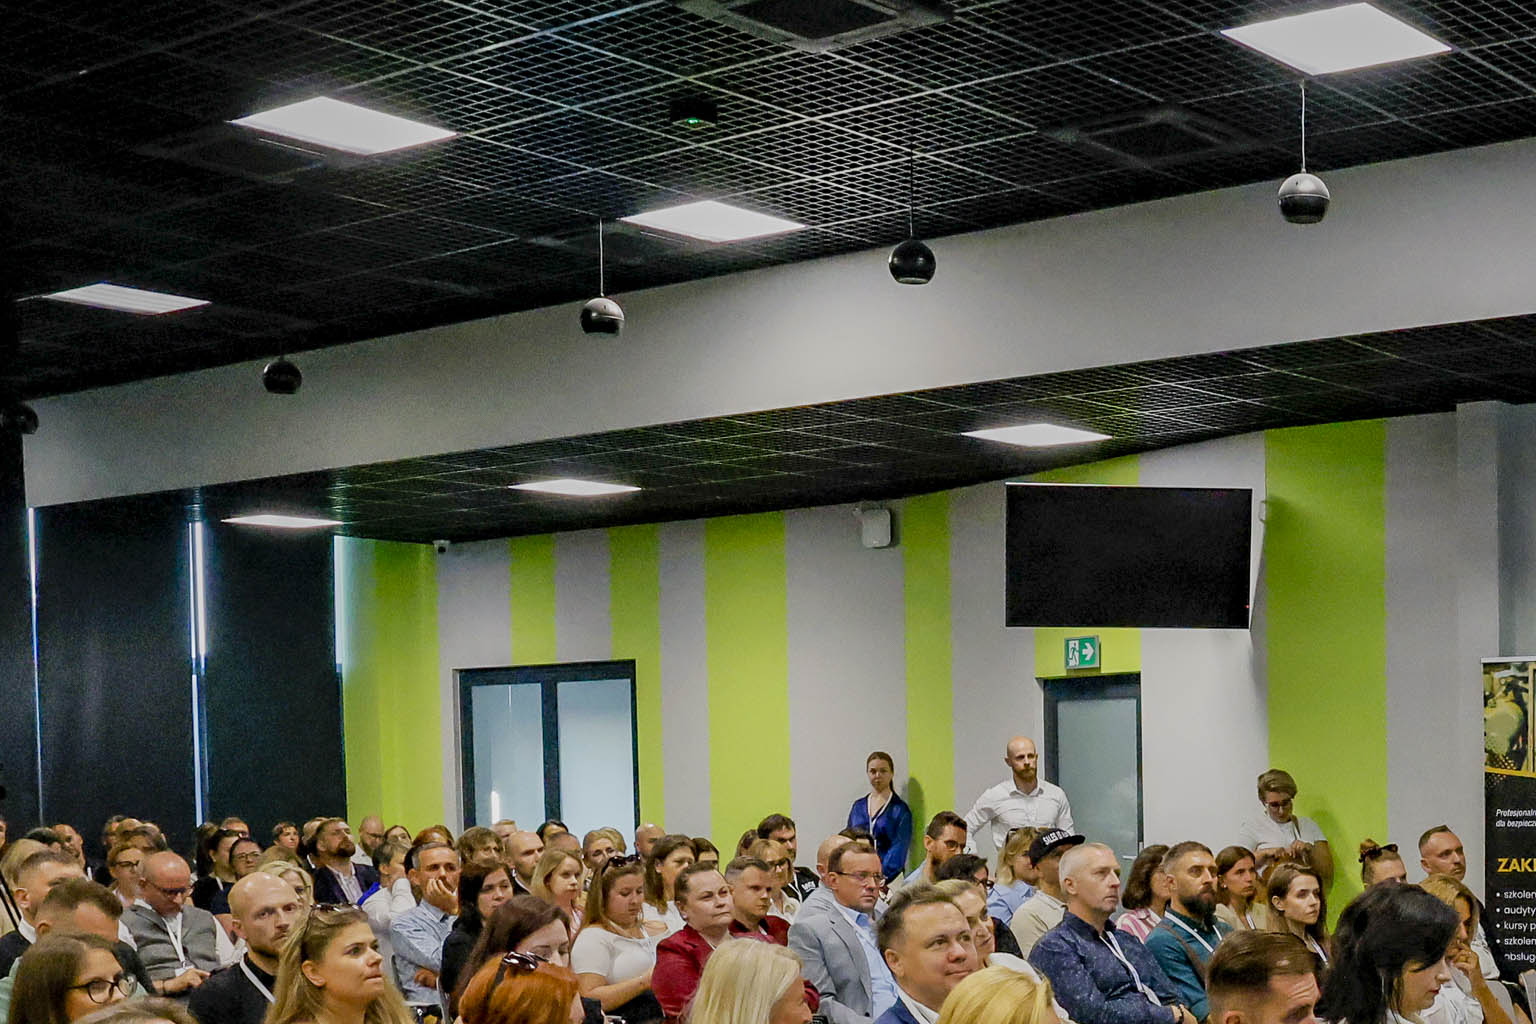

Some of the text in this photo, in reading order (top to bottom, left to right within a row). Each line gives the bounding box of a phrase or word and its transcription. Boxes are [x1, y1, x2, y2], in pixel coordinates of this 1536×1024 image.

[1495, 819, 1506, 828] dla
[1503, 905, 1536, 917] audyty
[1503, 920, 1528, 932] kursy
